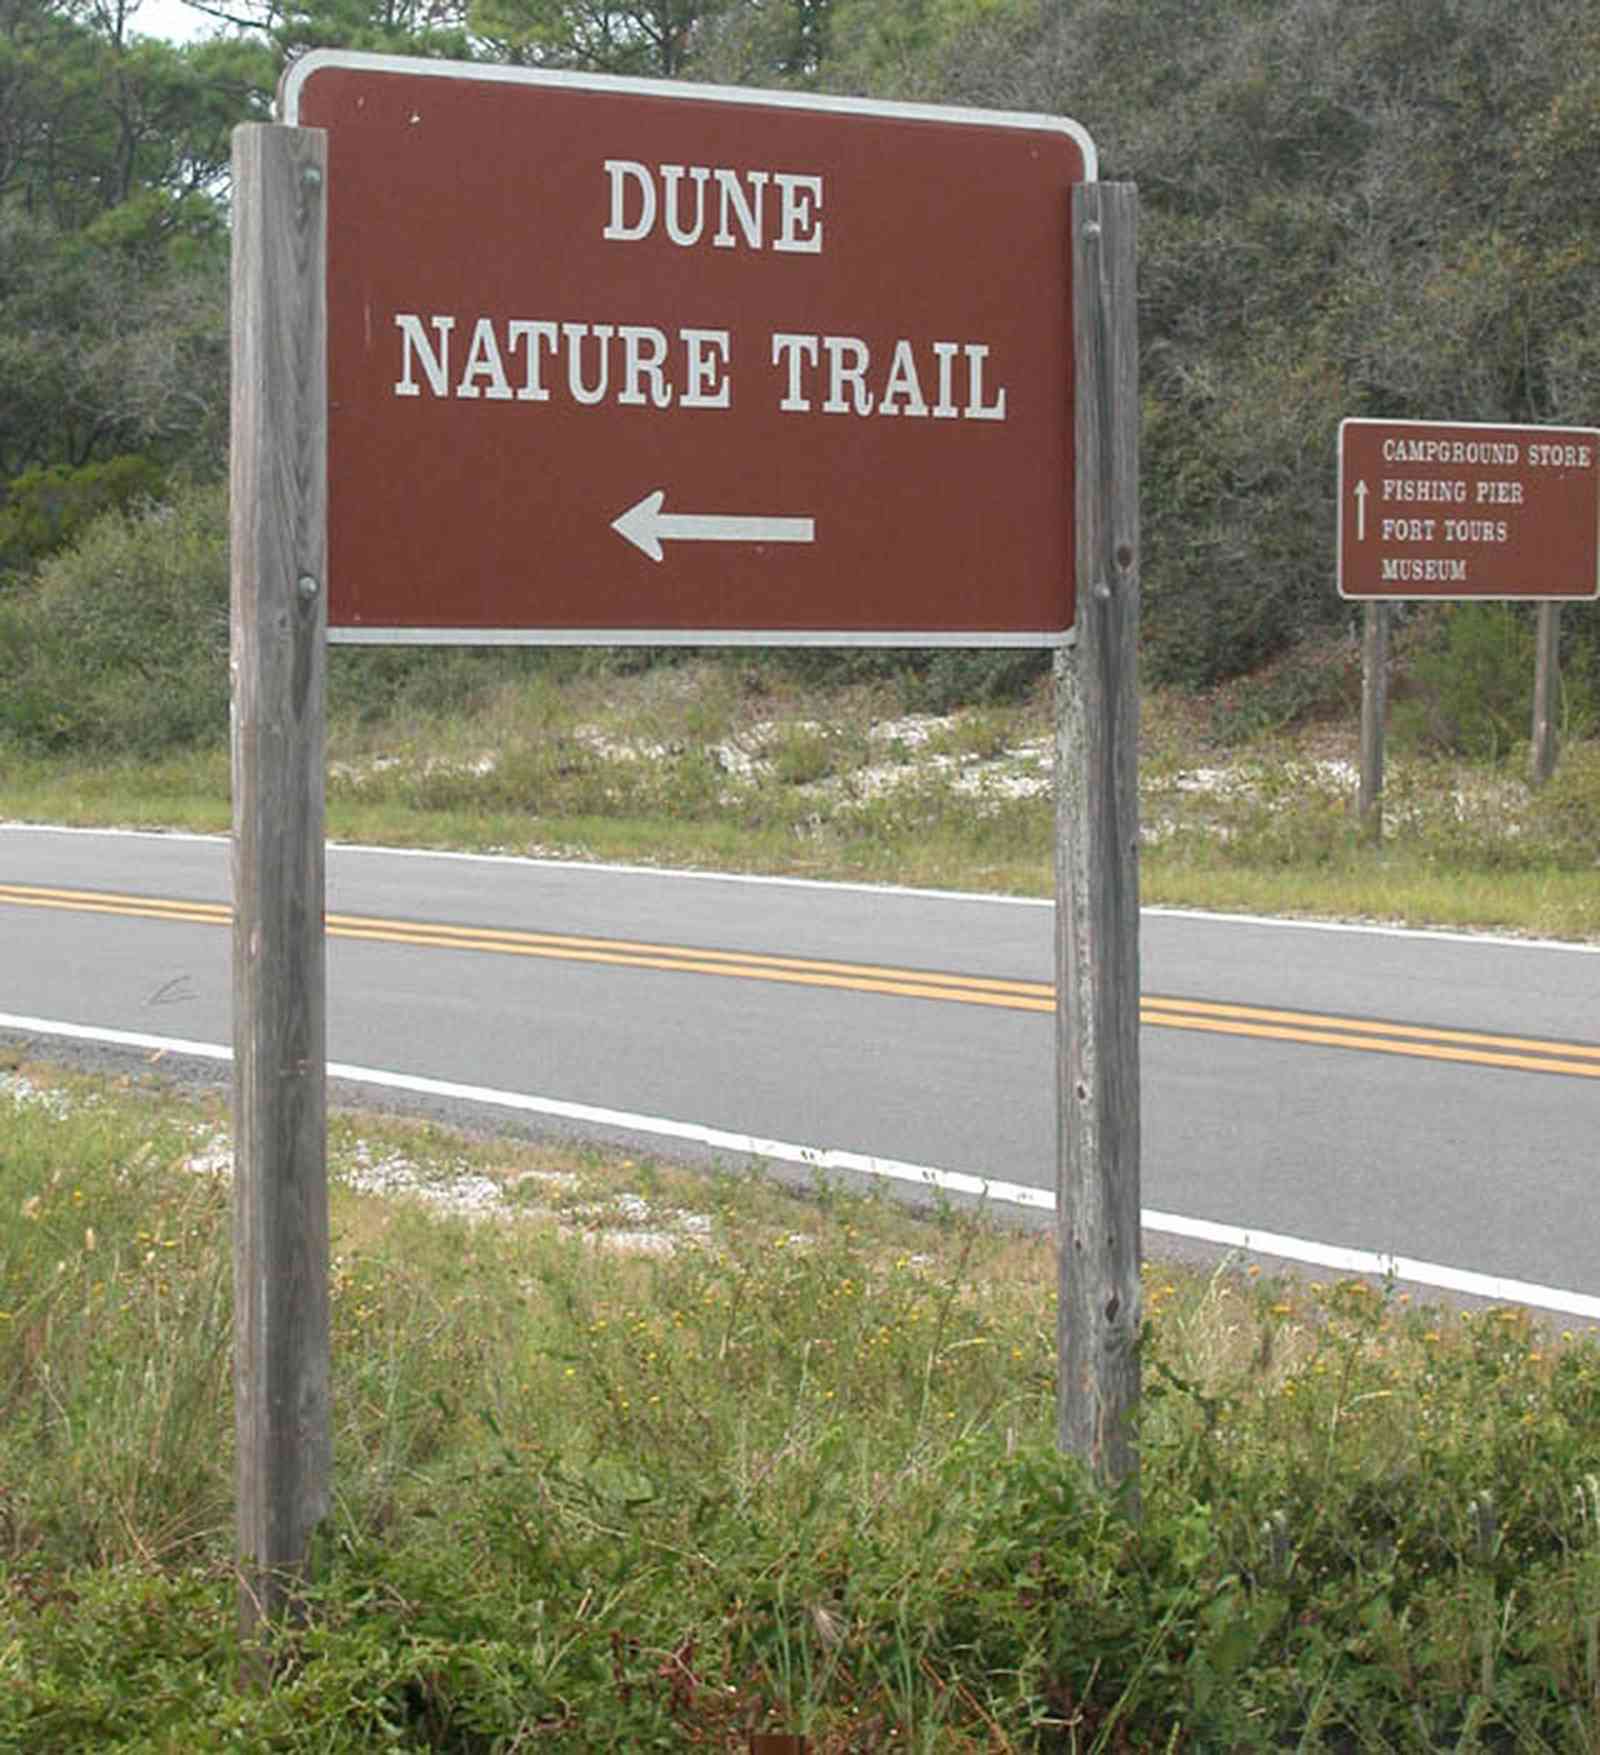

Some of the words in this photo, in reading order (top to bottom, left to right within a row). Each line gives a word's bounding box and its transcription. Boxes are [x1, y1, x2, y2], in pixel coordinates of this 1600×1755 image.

[603, 159, 823, 254] DUNE
[394, 314, 730, 408] NATURE
[772, 333, 1006, 420] TRAIL
[1382, 438, 1519, 465] CAMPGROUND
[1528, 444, 1591, 467] STORE
[1382, 479, 1467, 503] FISHING
[1476, 481, 1523, 505] PIER
[1382, 518, 1436, 541] FORT
[1444, 519, 1507, 542] TOURS
[1381, 558, 1466, 581] MUSEUM
